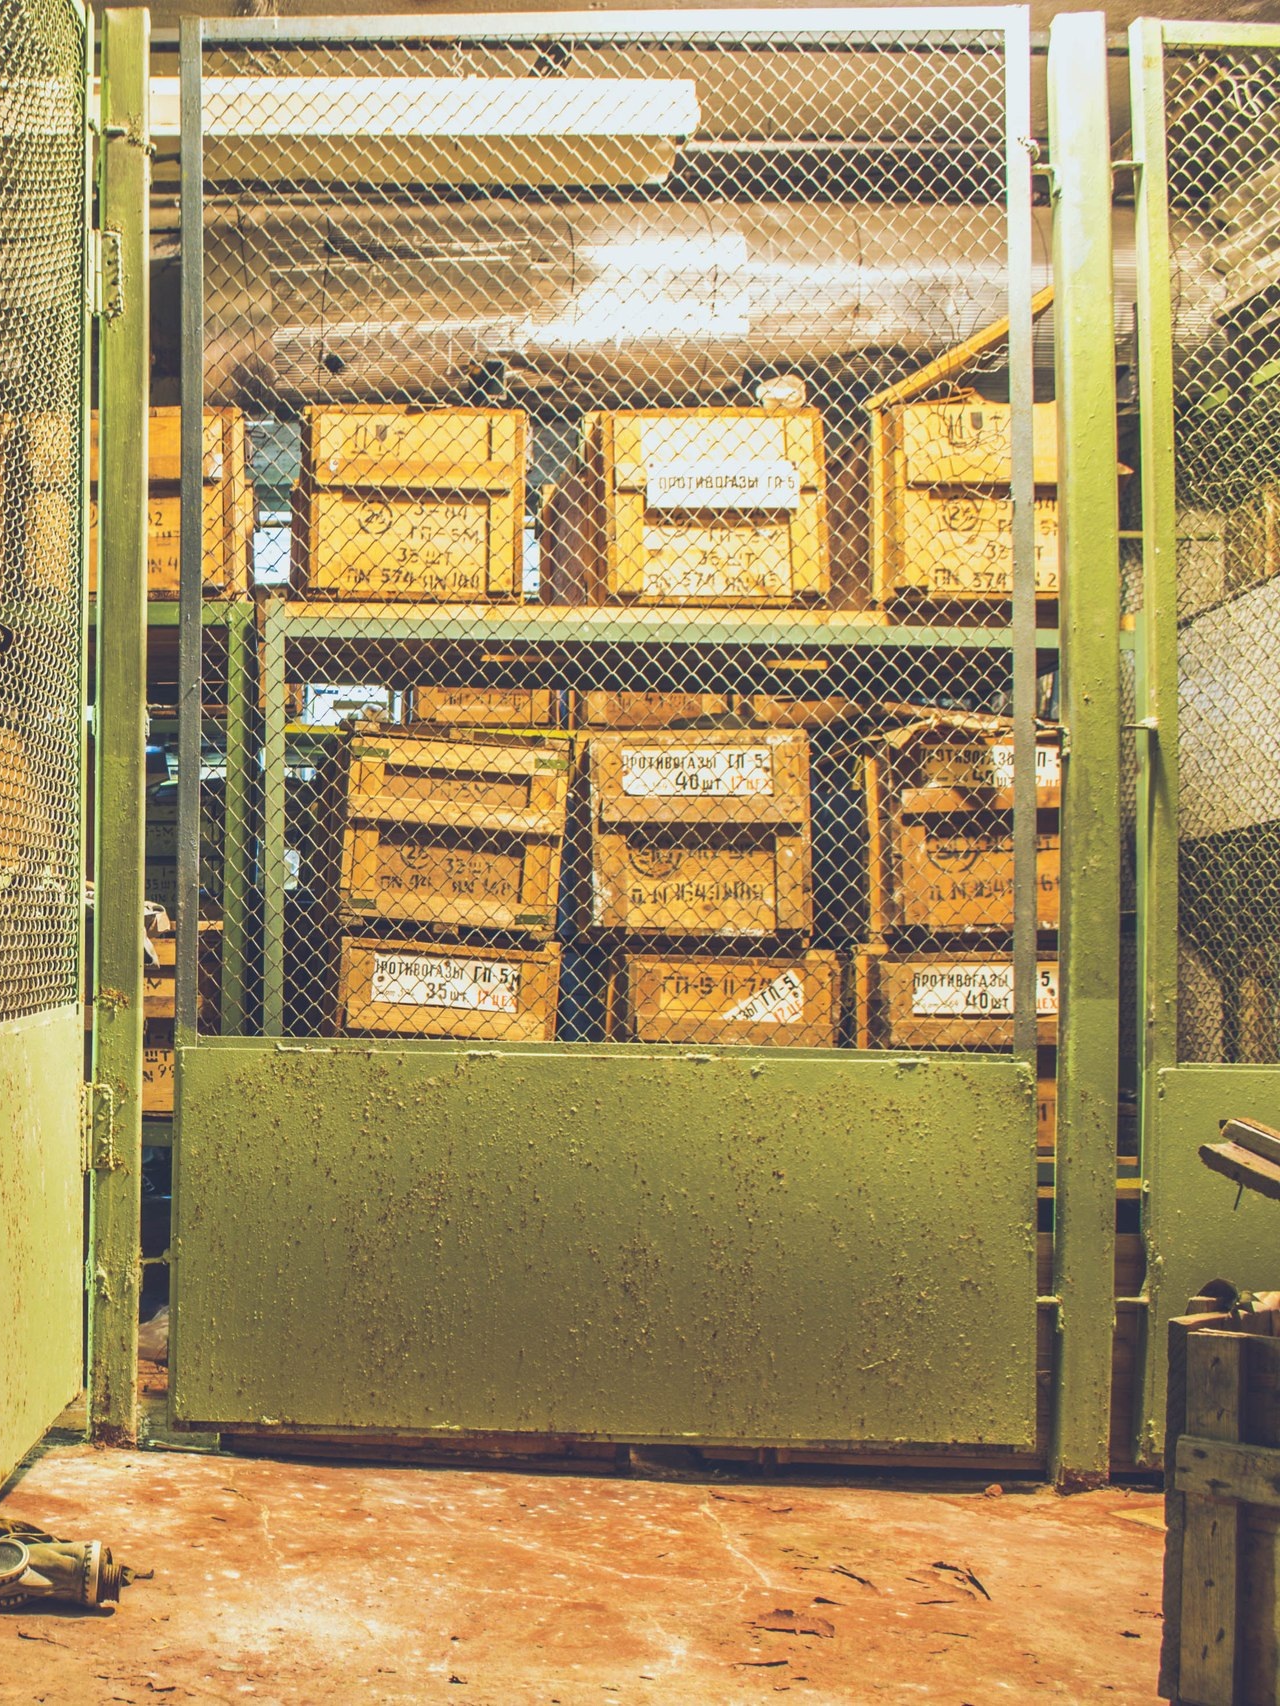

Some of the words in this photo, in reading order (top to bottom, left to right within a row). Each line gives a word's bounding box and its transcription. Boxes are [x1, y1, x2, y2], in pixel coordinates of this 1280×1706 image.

[658, 475, 759, 489] ПРОТИВОГАЗЫ
[622, 754, 717, 769] ПРОТИВОГАЗЫ
[675, 771, 699, 790] 40
[375, 958, 465, 980] ПРОТИВОГАЗЫ
[913, 972, 1009, 988] ПРОТИВОГАЗЫ
[426, 982, 447, 1000] 35
[477, 990, 490, 1005] 17
[761, 976, 796, 1006] ГП-5
[965, 990, 988, 1009] 40
